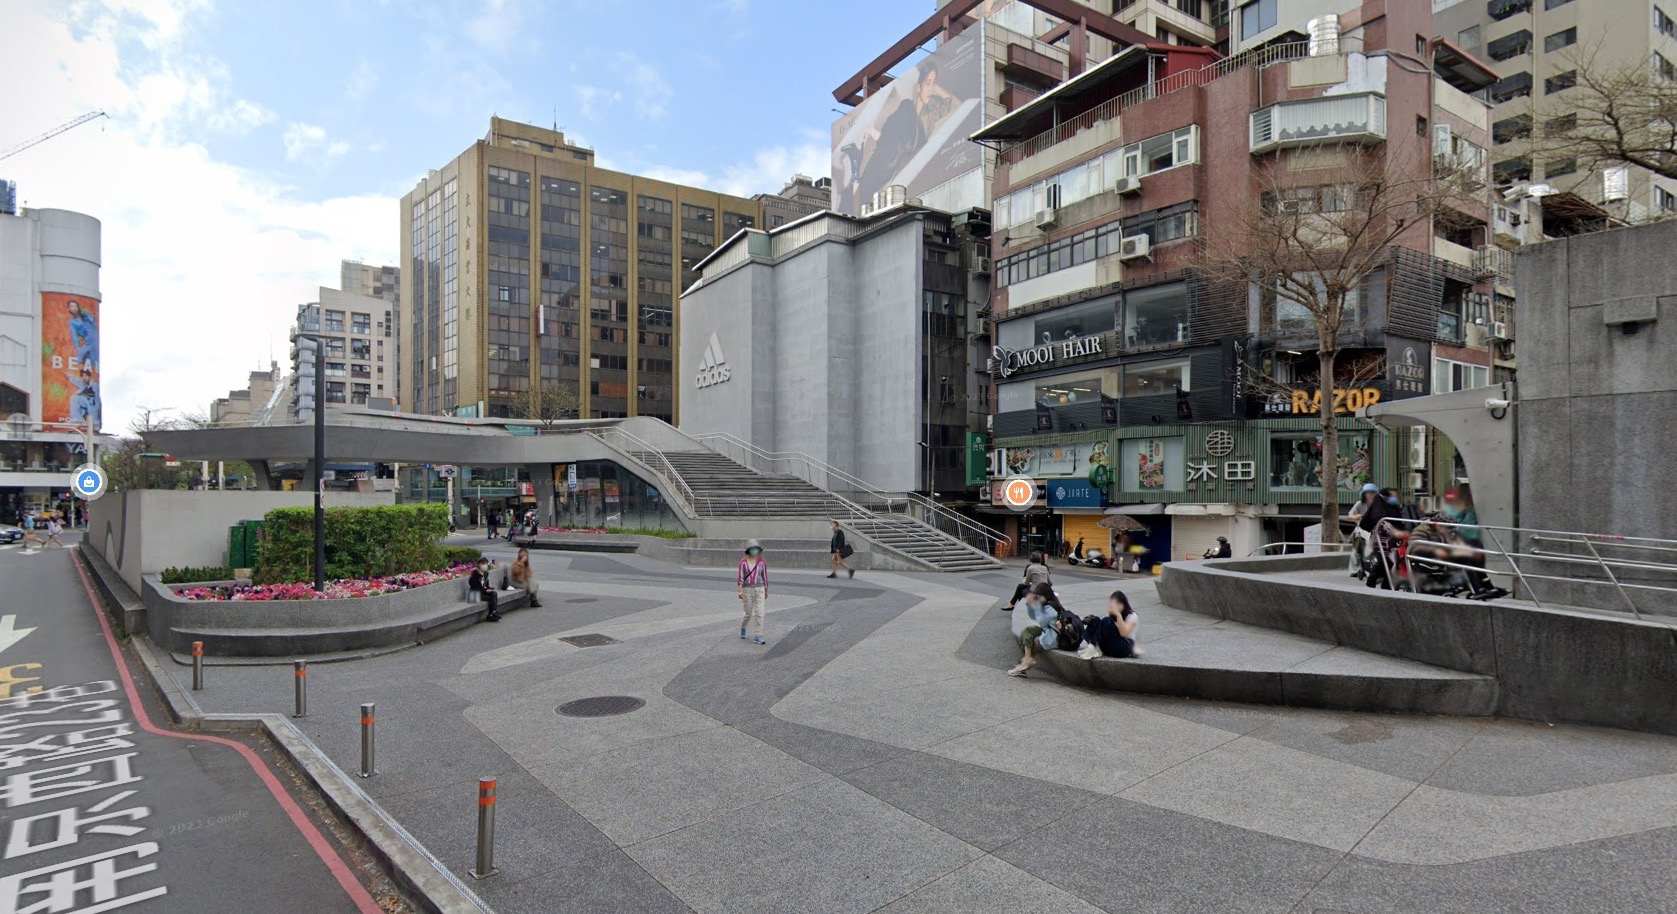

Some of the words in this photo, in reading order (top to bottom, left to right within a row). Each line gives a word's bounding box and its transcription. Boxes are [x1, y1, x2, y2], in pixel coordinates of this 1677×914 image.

[1017, 346, 1054, 367] MOOI
[1062, 336, 1102, 359] HAIR
[51, 356, 99, 371] BEA
[696, 366, 731, 389] adidas
[1187, 460, 1255, 482] 沐田
